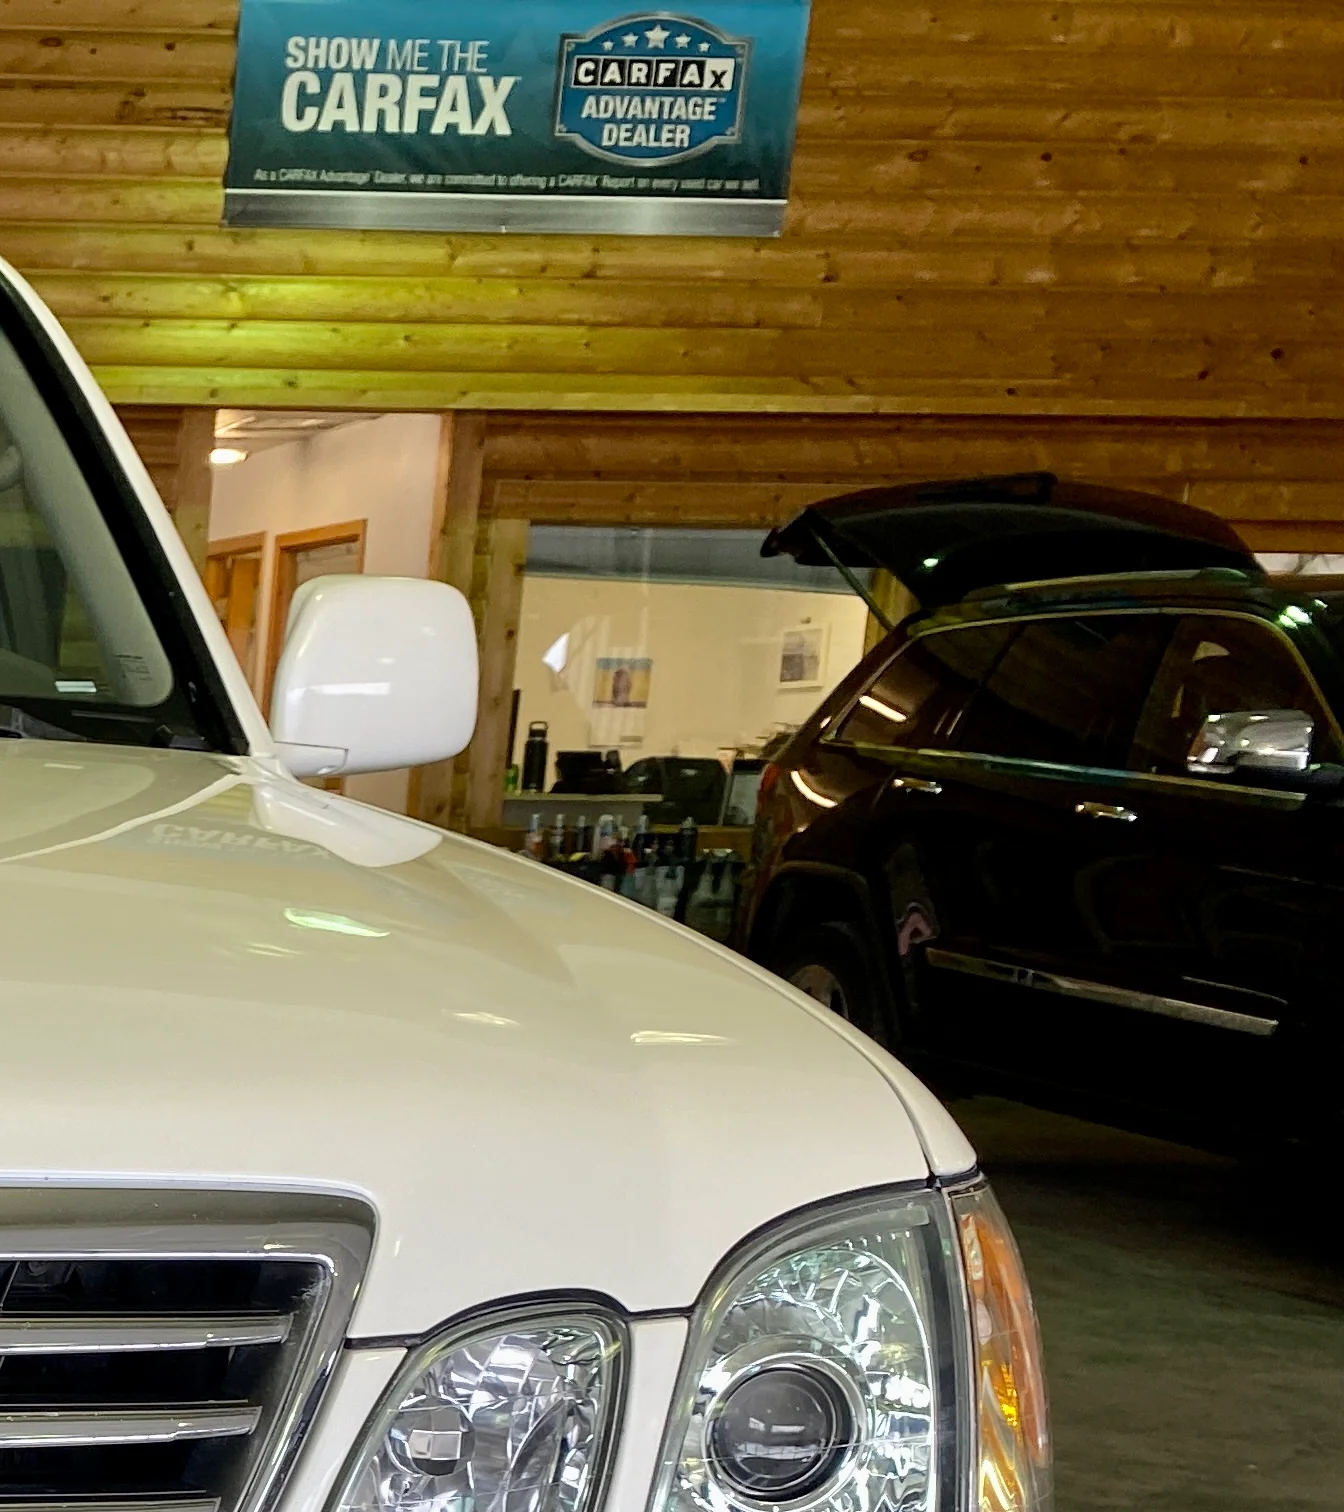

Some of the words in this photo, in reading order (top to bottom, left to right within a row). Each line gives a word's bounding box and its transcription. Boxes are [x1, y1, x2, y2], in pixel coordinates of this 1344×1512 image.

[285, 35, 381, 70] SHOW
[386, 38, 431, 71] ME
[437, 39, 490, 73] THE
[577, 60, 728, 89] CARFAX
[281, 70, 516, 136] CARFAX
[581, 95, 717, 120] ADVANTAGE
[601, 123, 691, 148] DEALER
